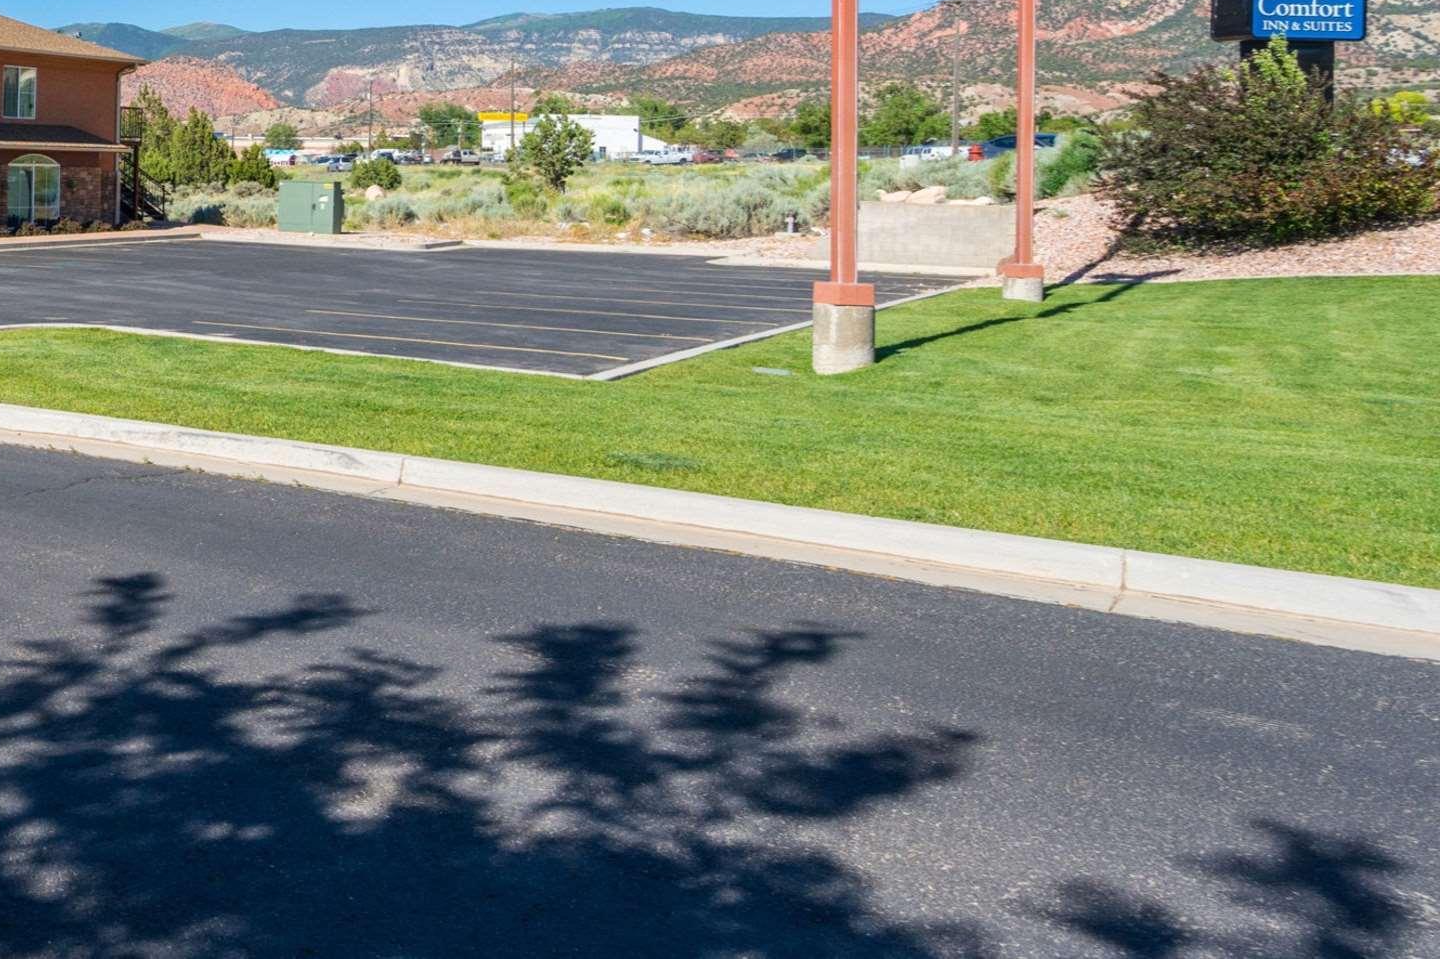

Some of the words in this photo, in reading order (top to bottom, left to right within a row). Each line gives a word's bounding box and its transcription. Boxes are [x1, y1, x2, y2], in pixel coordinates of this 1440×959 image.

[1262, 20, 1289, 31] INN
[1291, 21, 1301, 31] &
[1303, 21, 1353, 32] SUITES
